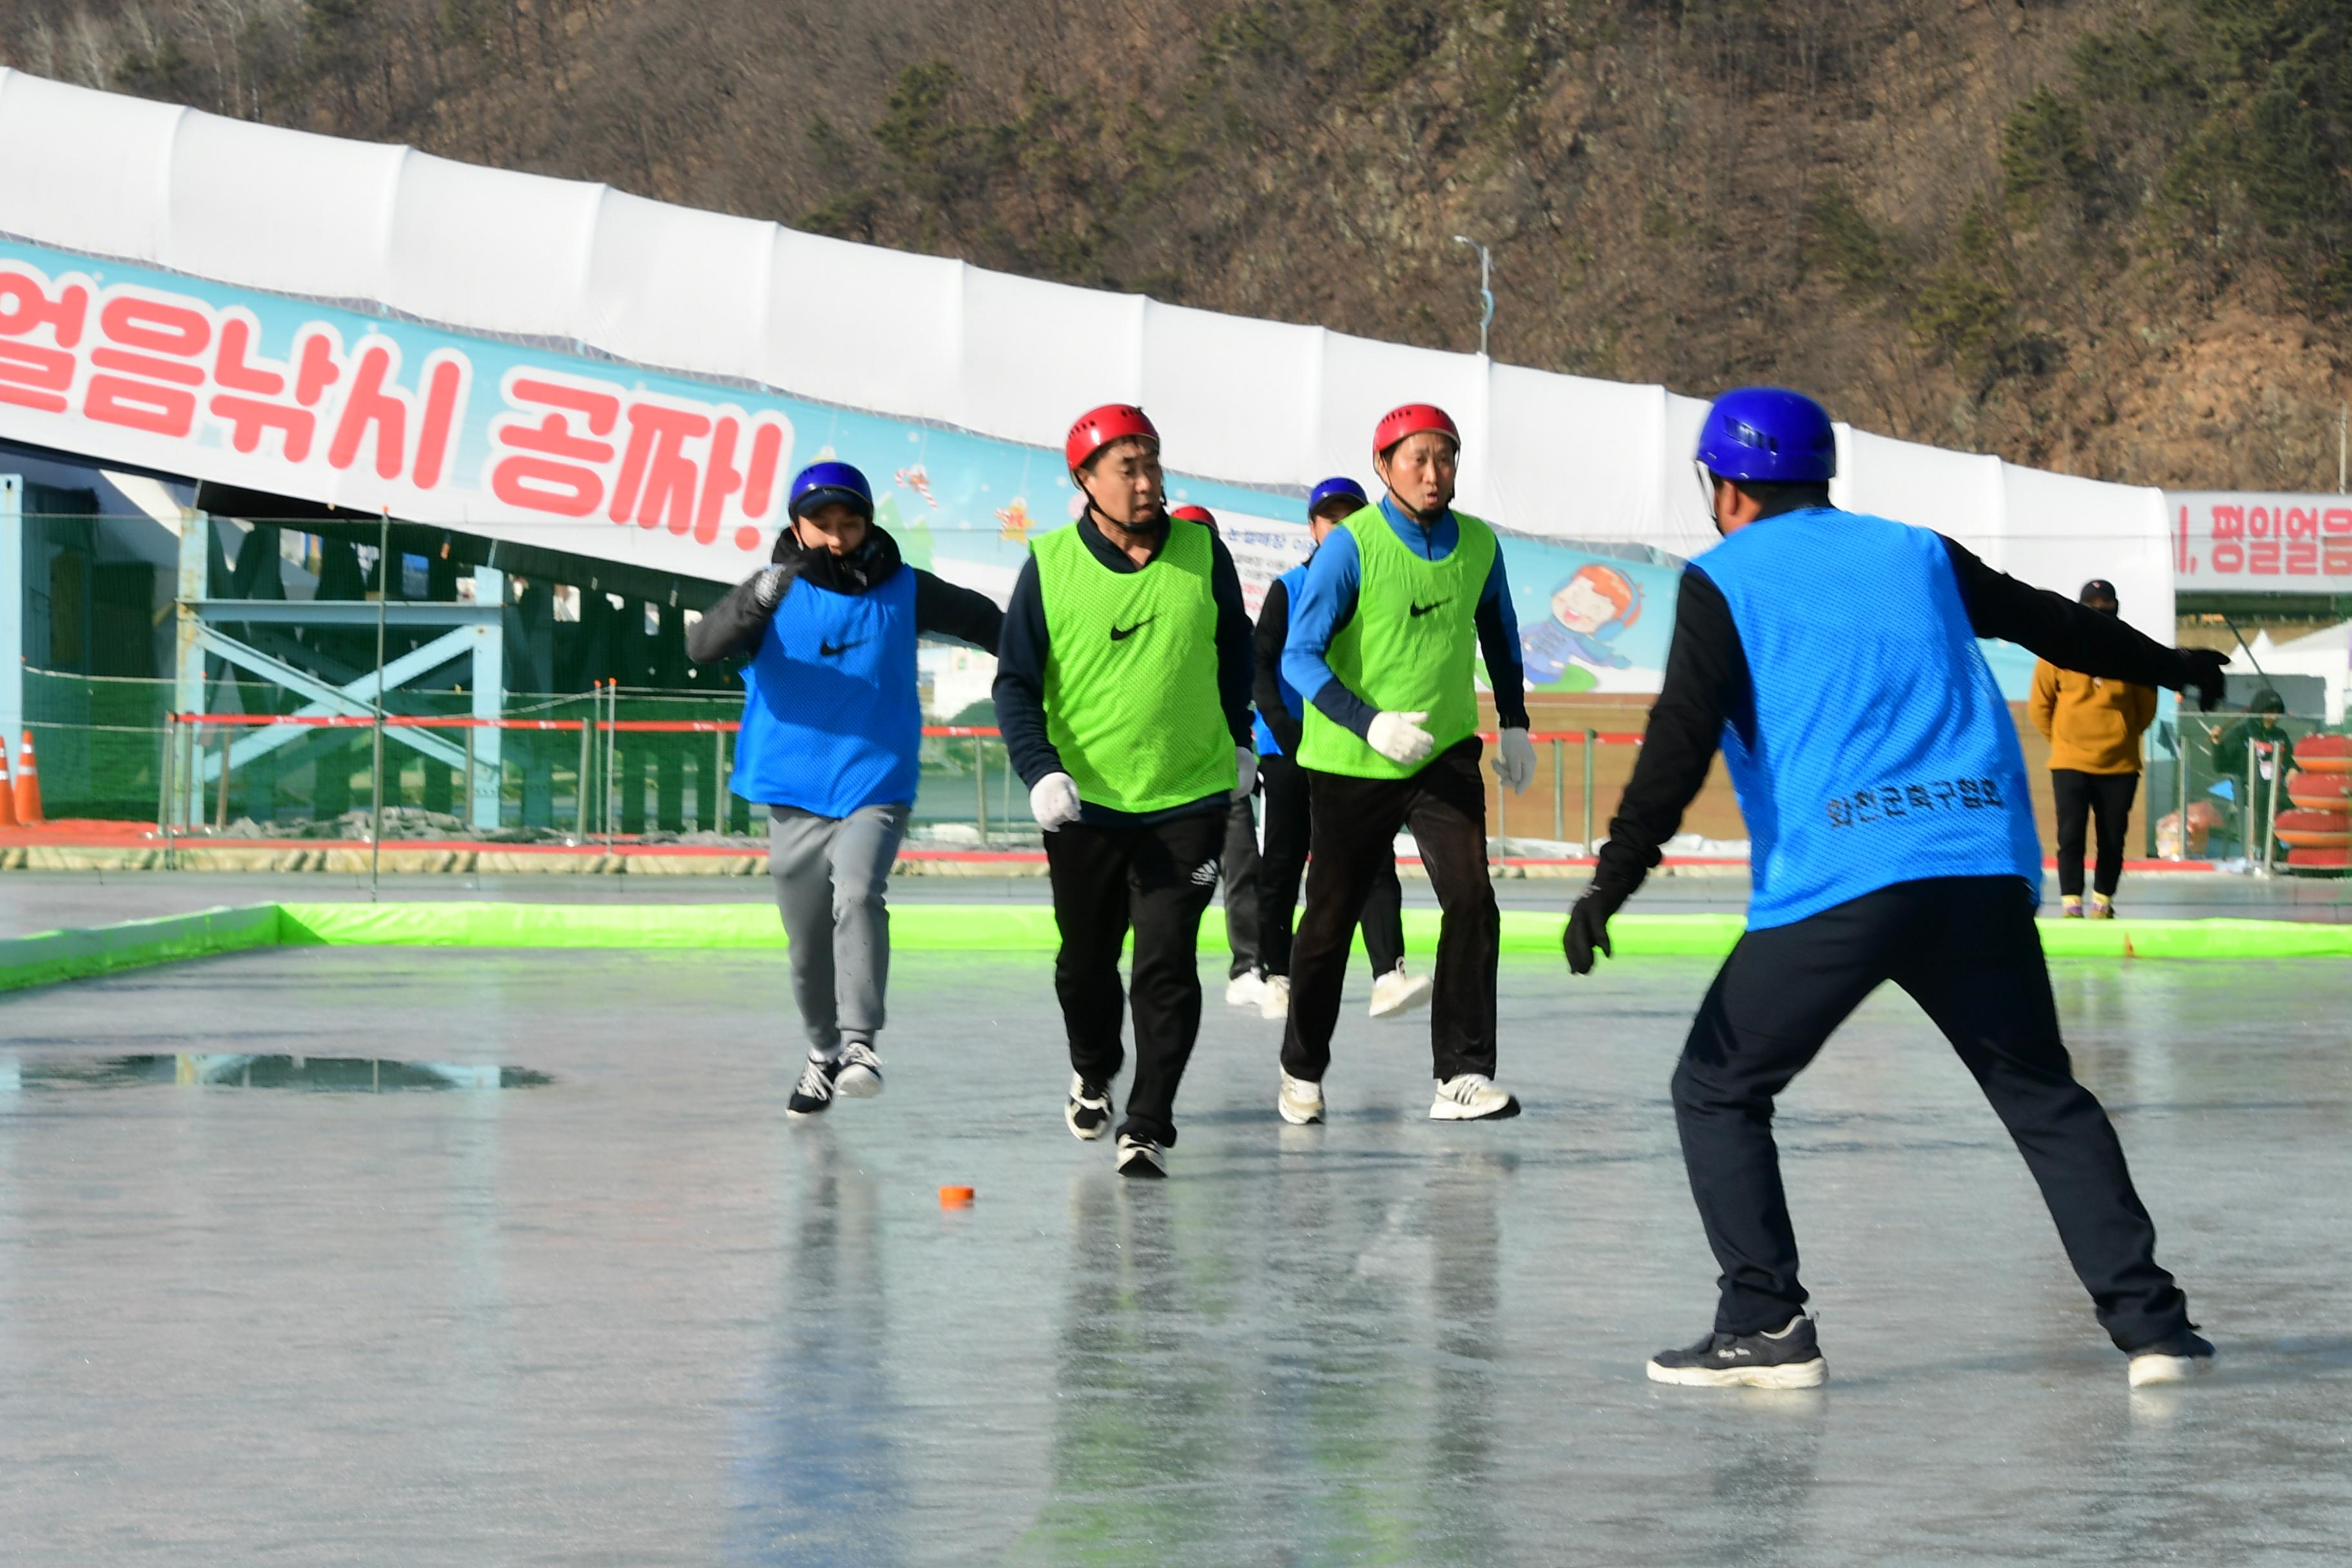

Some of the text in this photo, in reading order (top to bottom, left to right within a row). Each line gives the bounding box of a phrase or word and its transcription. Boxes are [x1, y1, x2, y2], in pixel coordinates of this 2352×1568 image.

[0, 271, 783, 553] 얼음낚시 공짜!
[2211, 505, 2352, 576] 평일얼음
